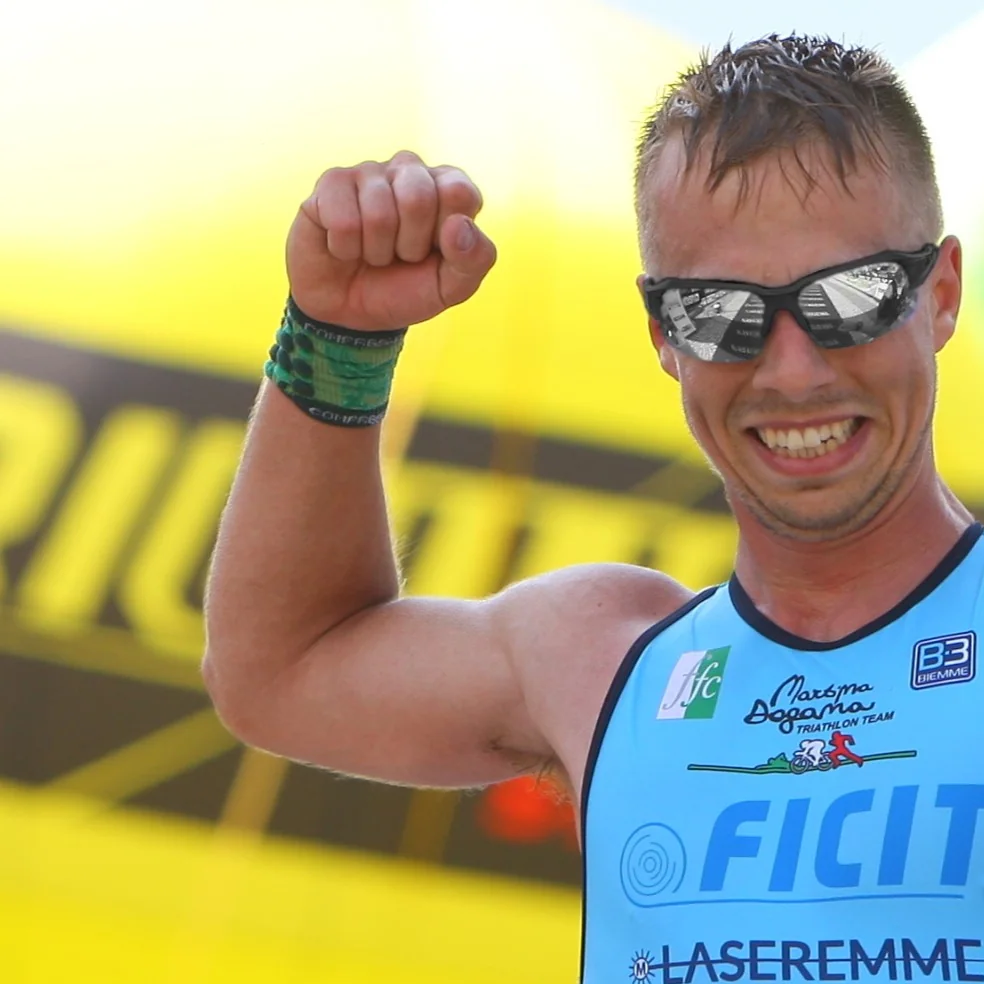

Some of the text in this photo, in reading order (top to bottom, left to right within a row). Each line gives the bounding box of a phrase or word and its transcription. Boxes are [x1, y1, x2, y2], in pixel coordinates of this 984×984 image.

[917, 667, 969, 684] BIEMME
[797, 711, 895, 734] TRIATHLON TEAM
